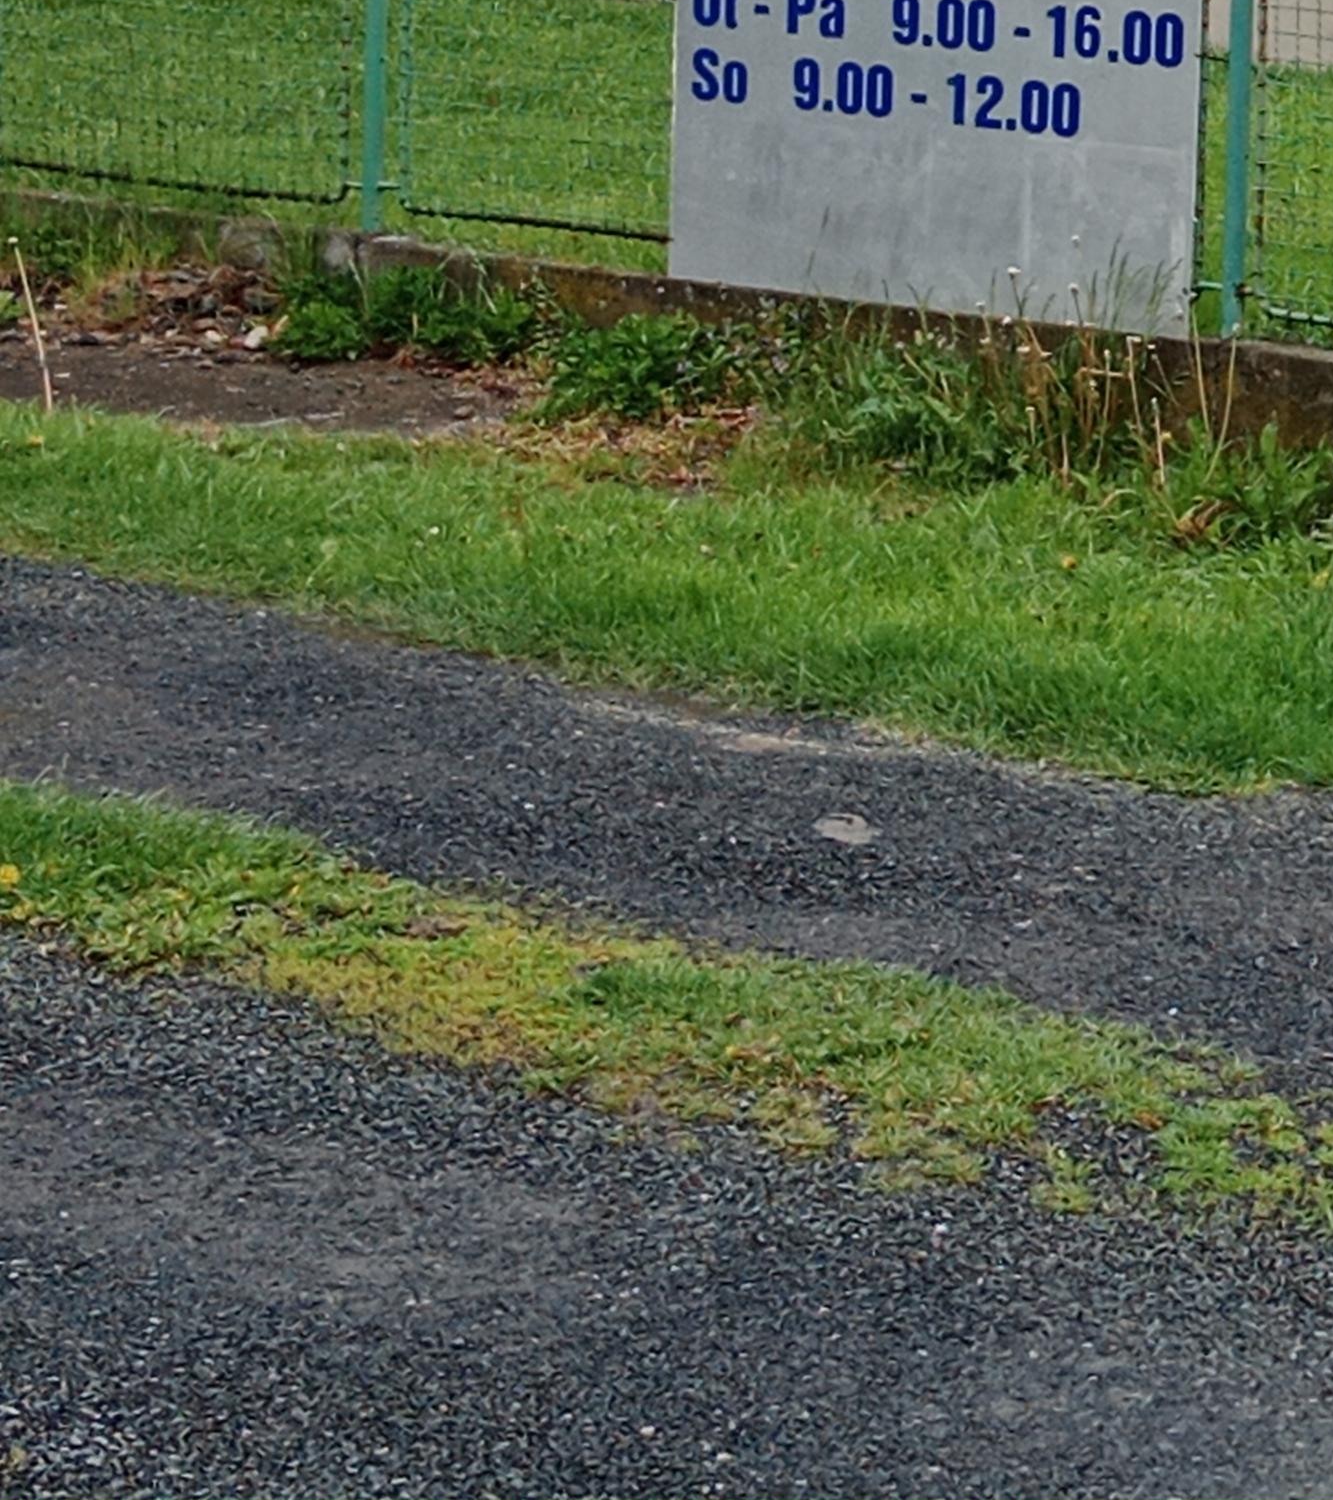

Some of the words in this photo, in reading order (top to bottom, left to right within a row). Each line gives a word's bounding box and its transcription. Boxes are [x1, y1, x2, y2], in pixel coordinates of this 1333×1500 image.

[753, 3, 770, 15] -
[1013, 26, 1031, 38] -
[1047, 5, 1185, 69] 16.00
[691, 47, 748, 105] So
[793, 57, 894, 118] 9.00
[910, 93, 928, 104] -
[946, 72, 1081, 138] 12.00
